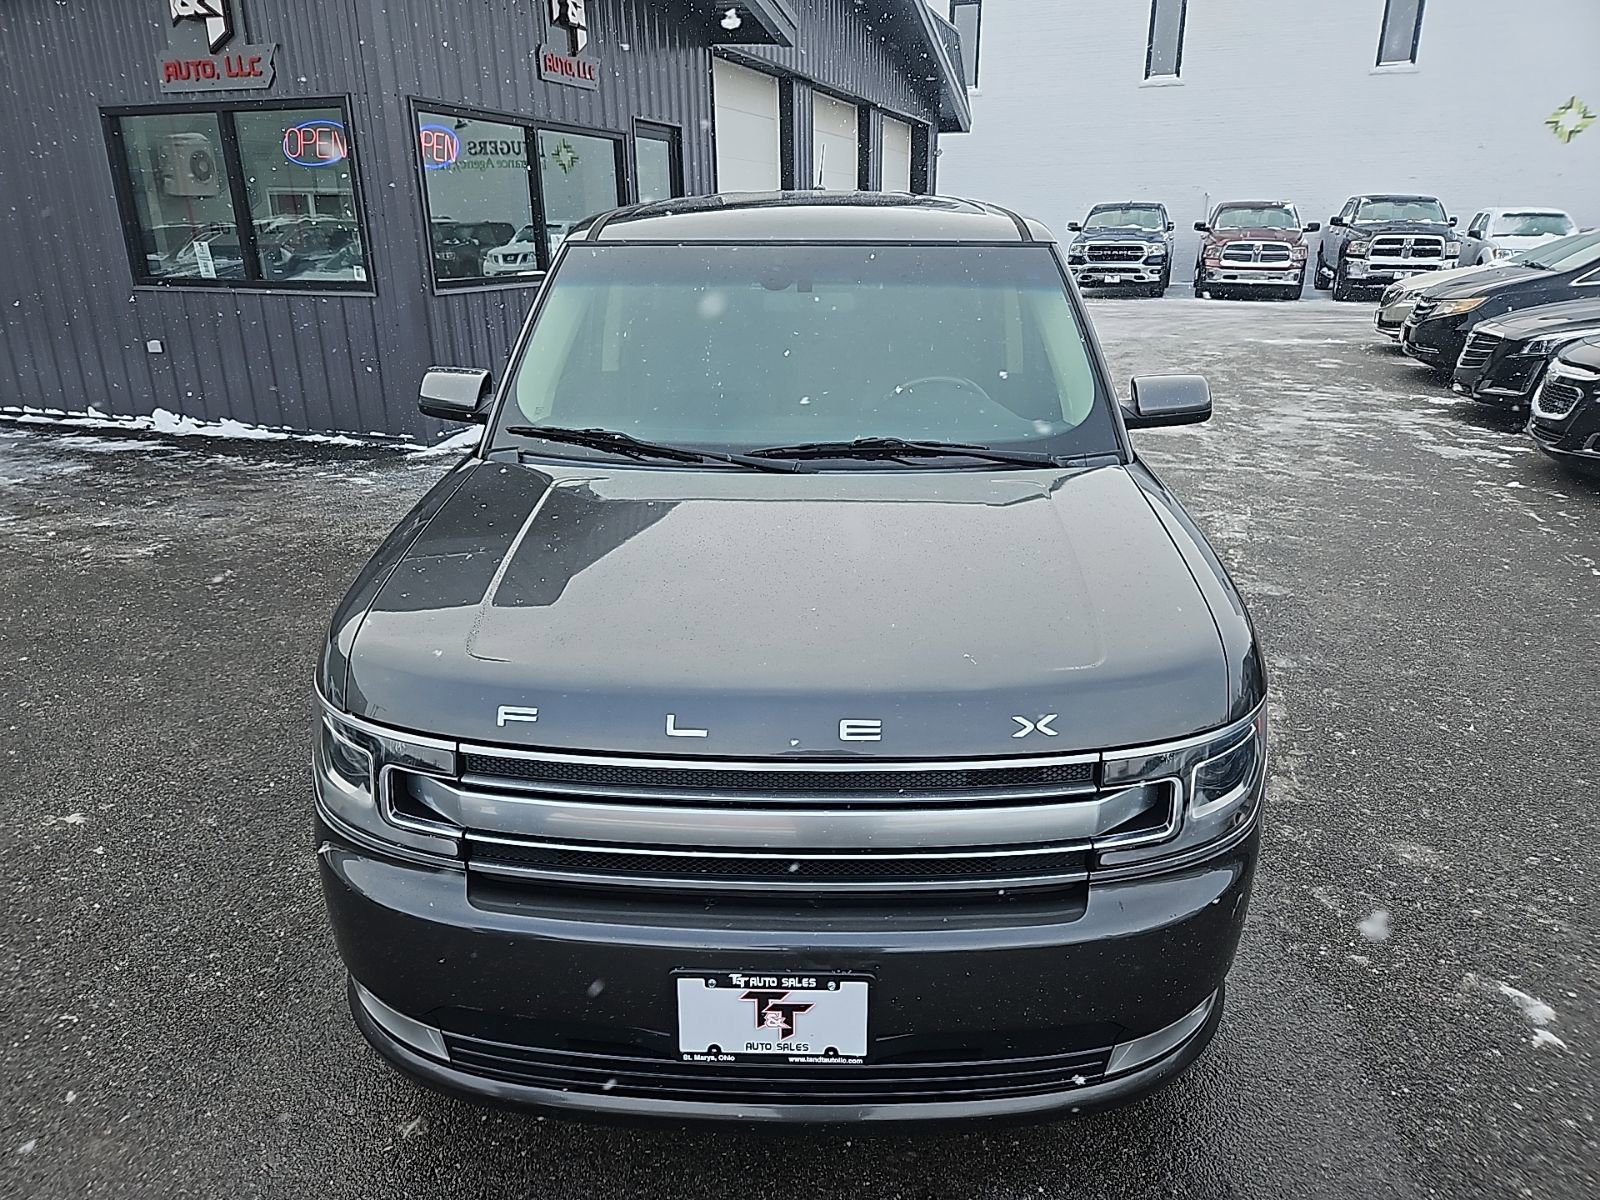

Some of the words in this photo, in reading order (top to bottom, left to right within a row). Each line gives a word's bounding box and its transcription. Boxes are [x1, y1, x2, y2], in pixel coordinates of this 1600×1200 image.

[163, 59, 220, 82] AUTO,
[225, 55, 263, 77] LLC
[577, 60, 596, 81] LLC
[285, 127, 348, 158] OPEN
[420, 130, 457, 162] PEN
[496, 704, 1059, 741] FLEX
[749, 977, 778, 988] AUTO
[781, 977, 817, 988] SALES
[738, 991, 816, 1041] T&T
[745, 1042, 772, 1051] AUTO
[776, 1043, 809, 1051] SALES
